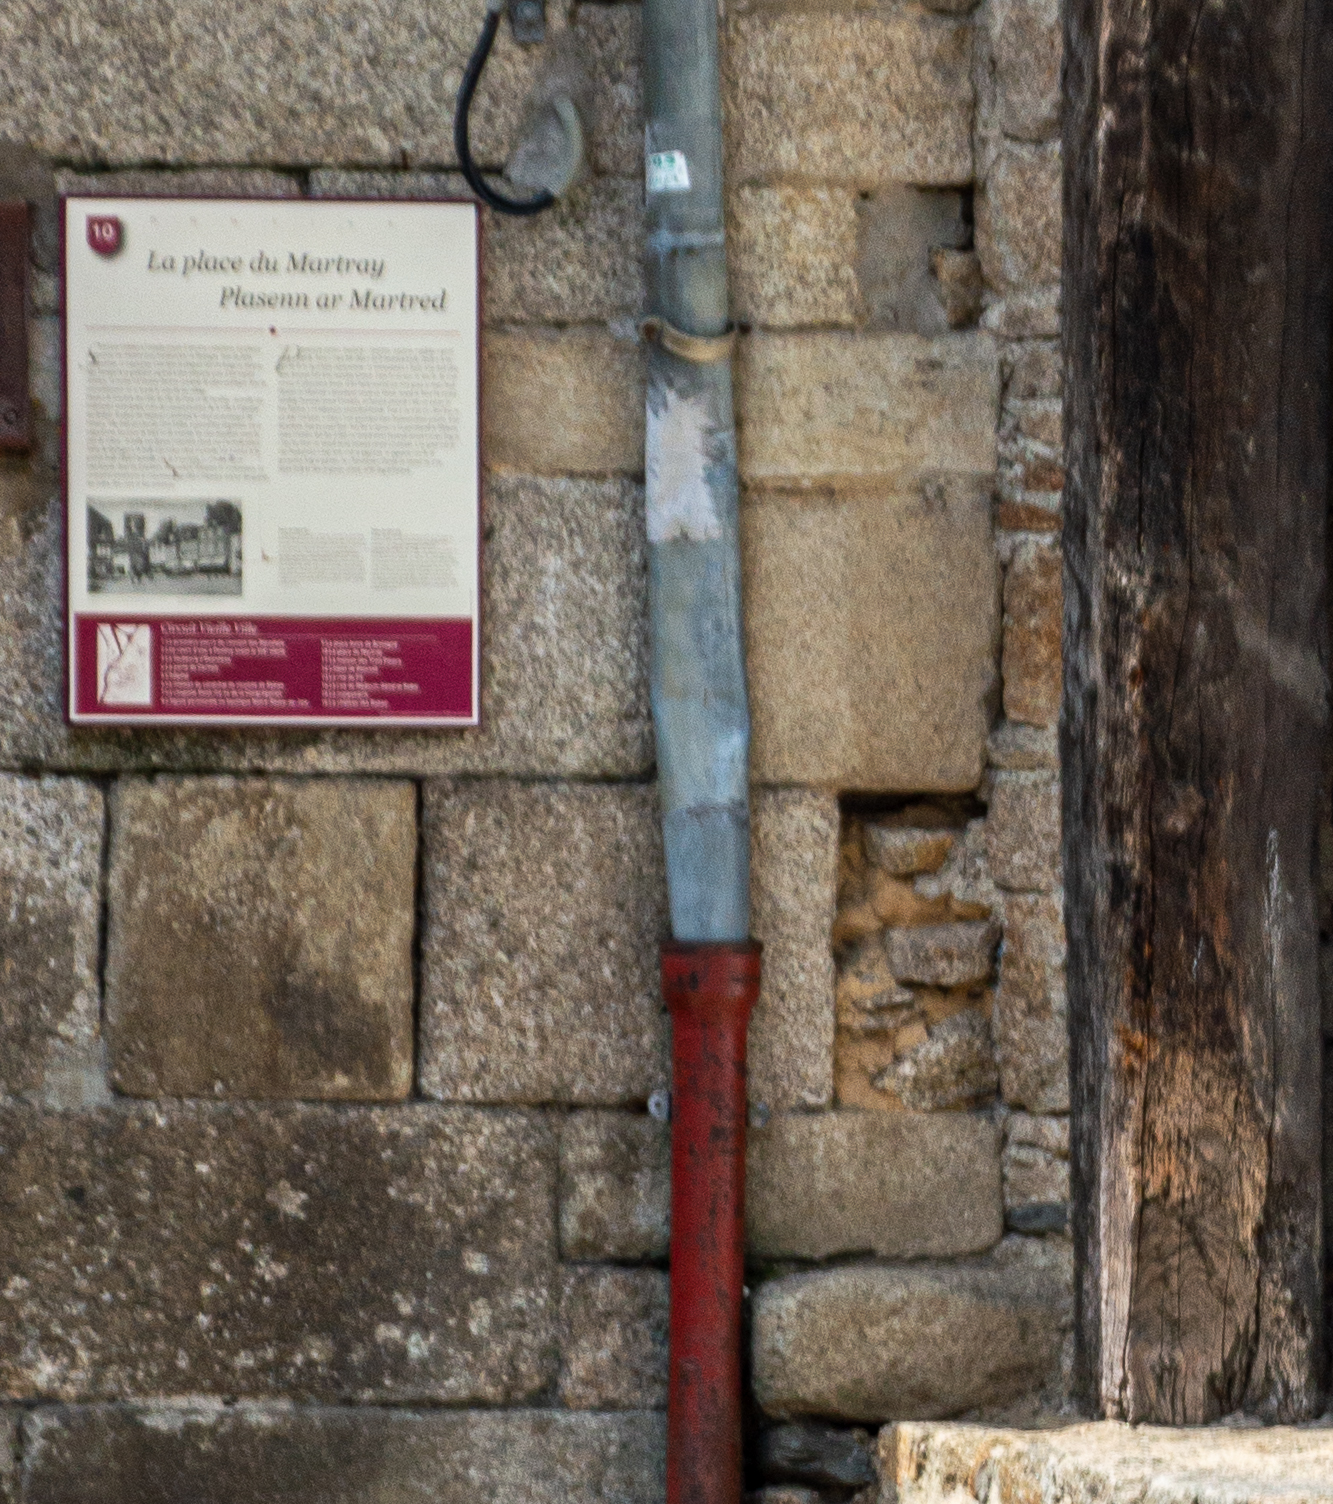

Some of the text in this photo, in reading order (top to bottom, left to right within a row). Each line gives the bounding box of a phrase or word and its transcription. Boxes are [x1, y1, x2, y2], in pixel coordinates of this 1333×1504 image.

[93, 221, 113, 241] 10
[148, 249, 386, 279] La place du Martray
[220, 286, 448, 311] Plasenn ar Martred
